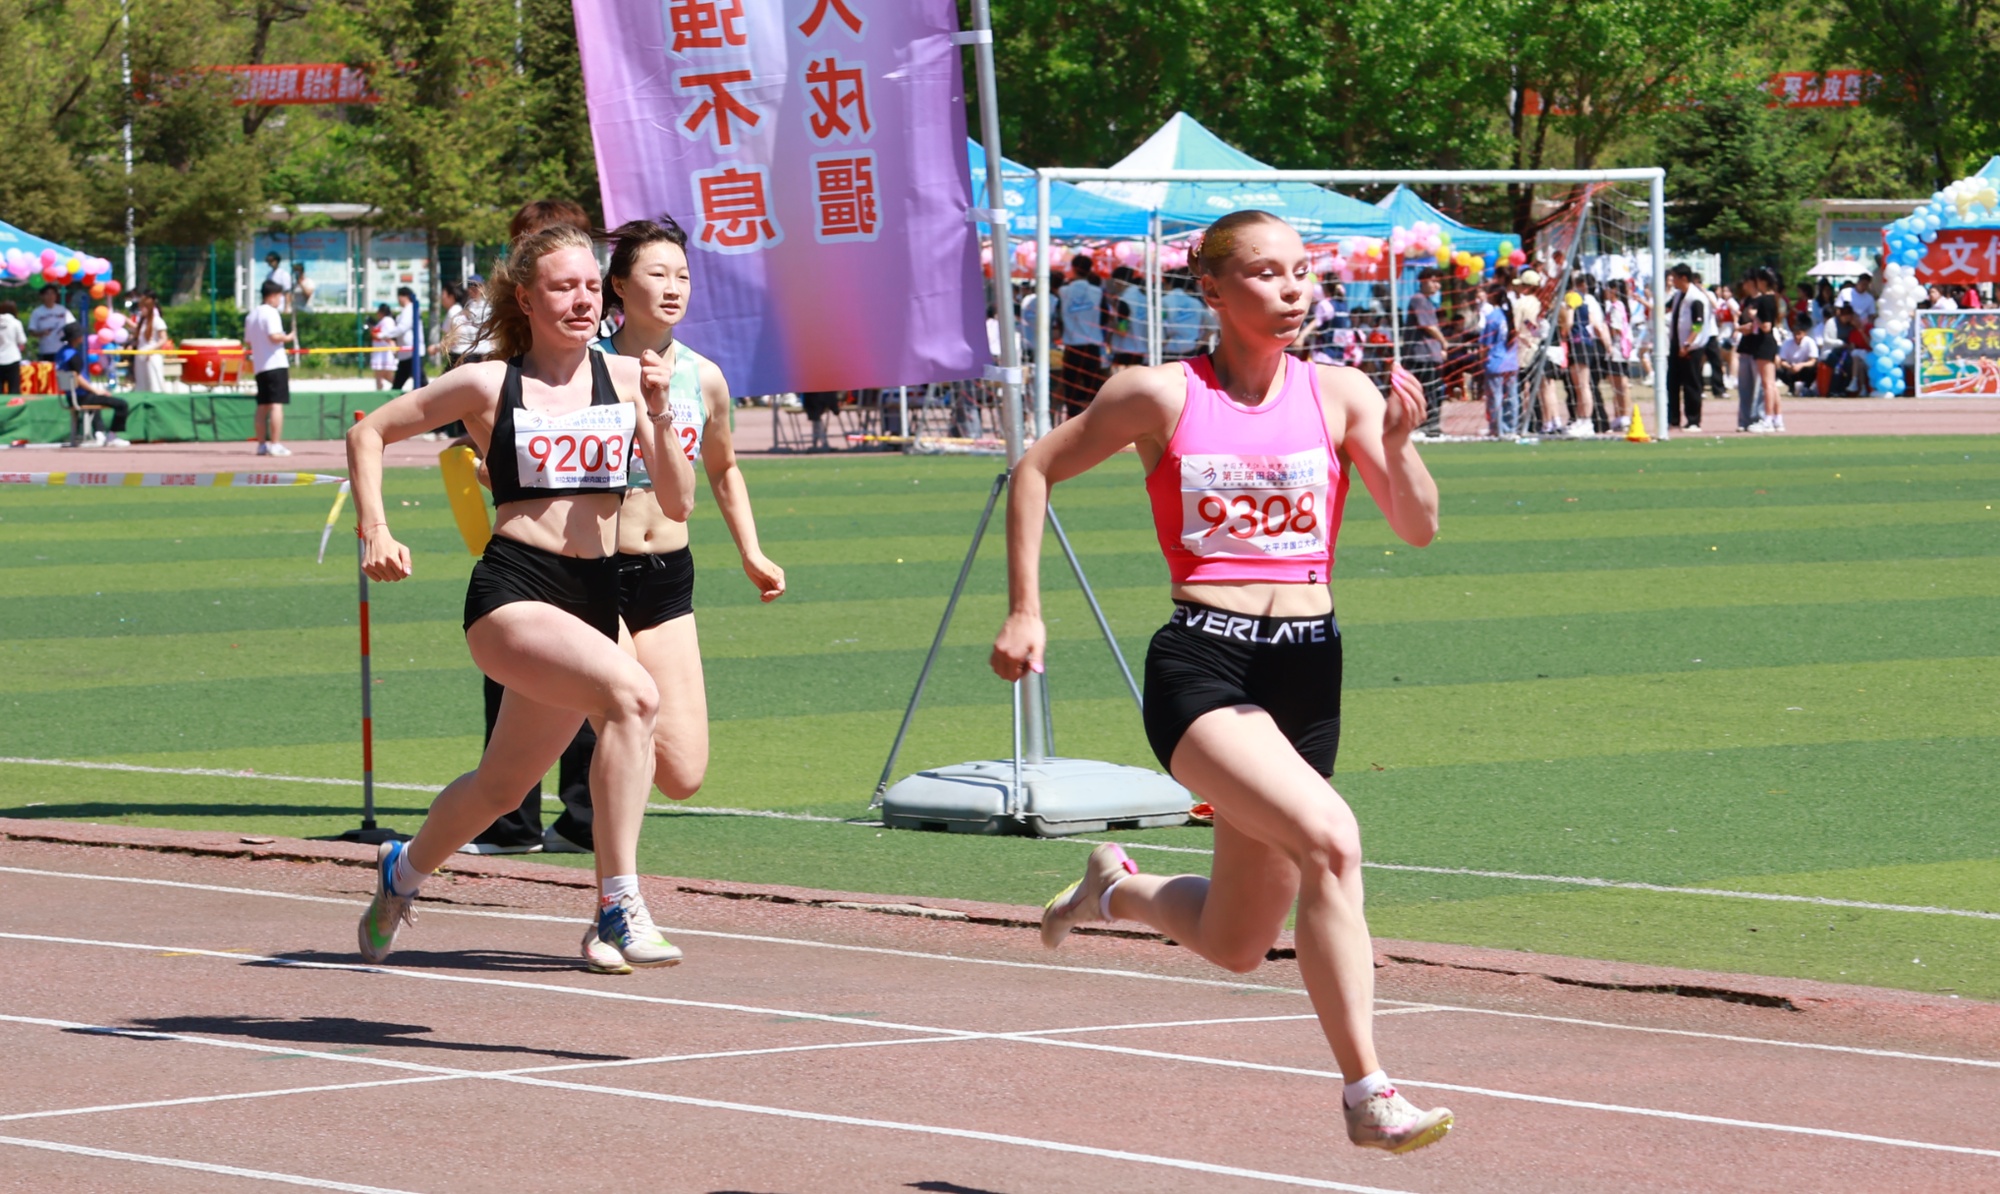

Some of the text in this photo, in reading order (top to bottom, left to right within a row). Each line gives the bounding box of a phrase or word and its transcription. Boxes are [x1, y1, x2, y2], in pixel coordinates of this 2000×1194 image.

[528, 434, 624, 473] 9203
[1222, 467, 1314, 482] 第三届田径运动大会
[1198, 491, 1317, 539] 9308
[1263, 538, 1317, 553] 太平洋国立大学
